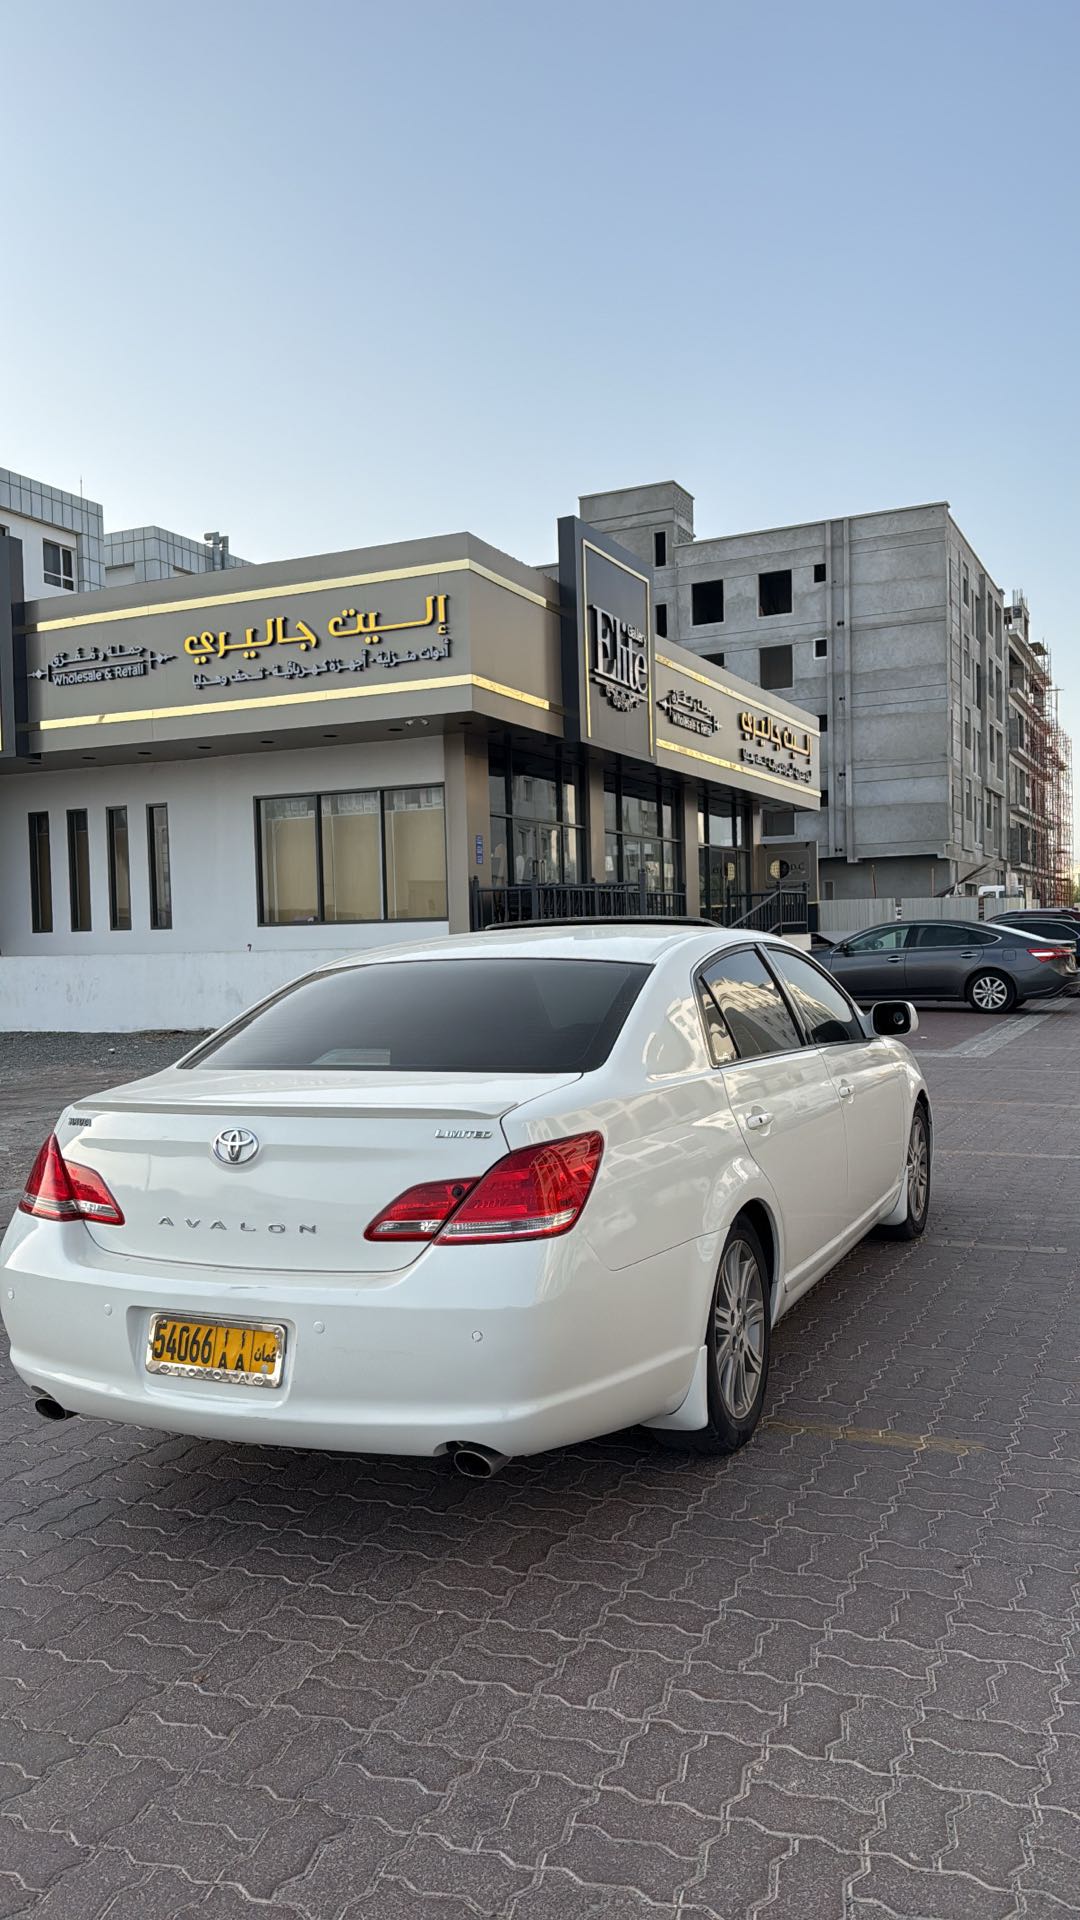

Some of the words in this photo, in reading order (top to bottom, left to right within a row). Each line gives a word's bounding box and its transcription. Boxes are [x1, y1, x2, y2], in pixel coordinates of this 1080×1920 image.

[328, 594, 448, 645] إليت
[184, 616, 318, 664] جاليري
[419, 638, 450, 661] أدوات
[592, 604, 648, 694] Elite
[328, 648, 369, 672] أجهزة
[51, 670, 102, 686] Wholesale
[104, 668, 113, 679] &
[115, 663, 145, 677] Retail
[158, 1215, 317, 1235] AVALON
[153, 1320, 213, 1364] 54066
[218, 1351, 228, 1369] A
[234, 1353, 246, 1371] A
